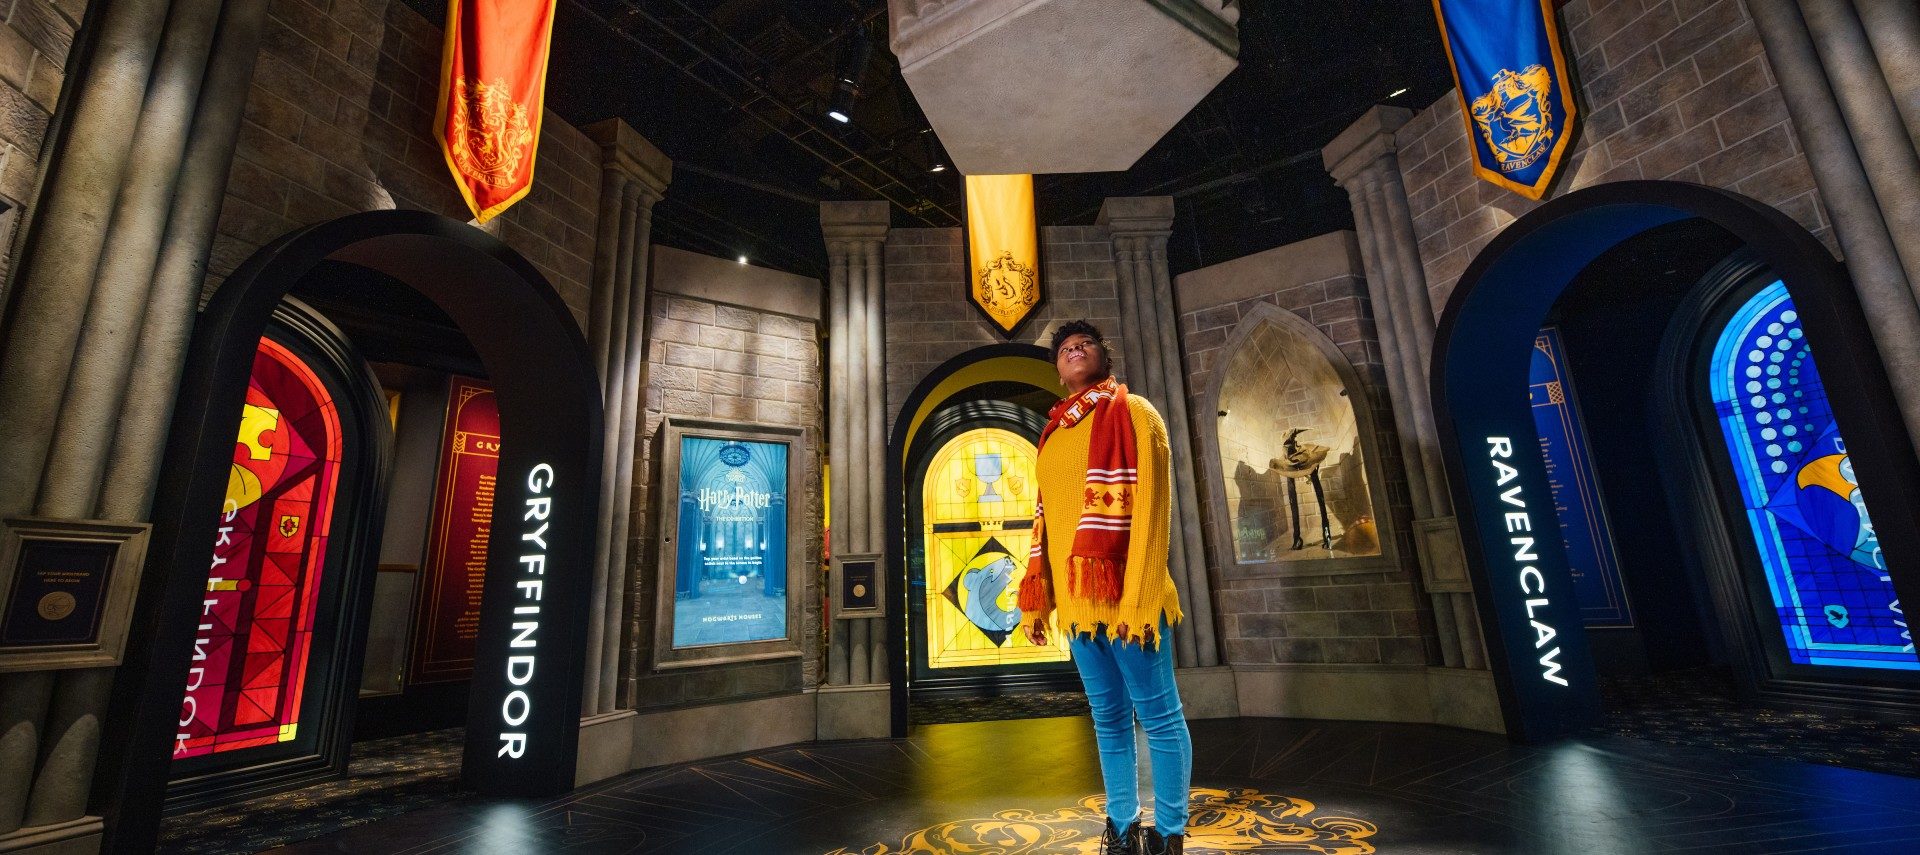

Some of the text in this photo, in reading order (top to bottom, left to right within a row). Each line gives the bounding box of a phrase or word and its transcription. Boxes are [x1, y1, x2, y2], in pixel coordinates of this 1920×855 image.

[697, 485, 771, 512] Harry Potter
[1487, 436, 1569, 687] RAVENCLAW
[497, 462, 554, 759] GRYFFINDOR
[702, 614, 737, 623] HOGWARTS
